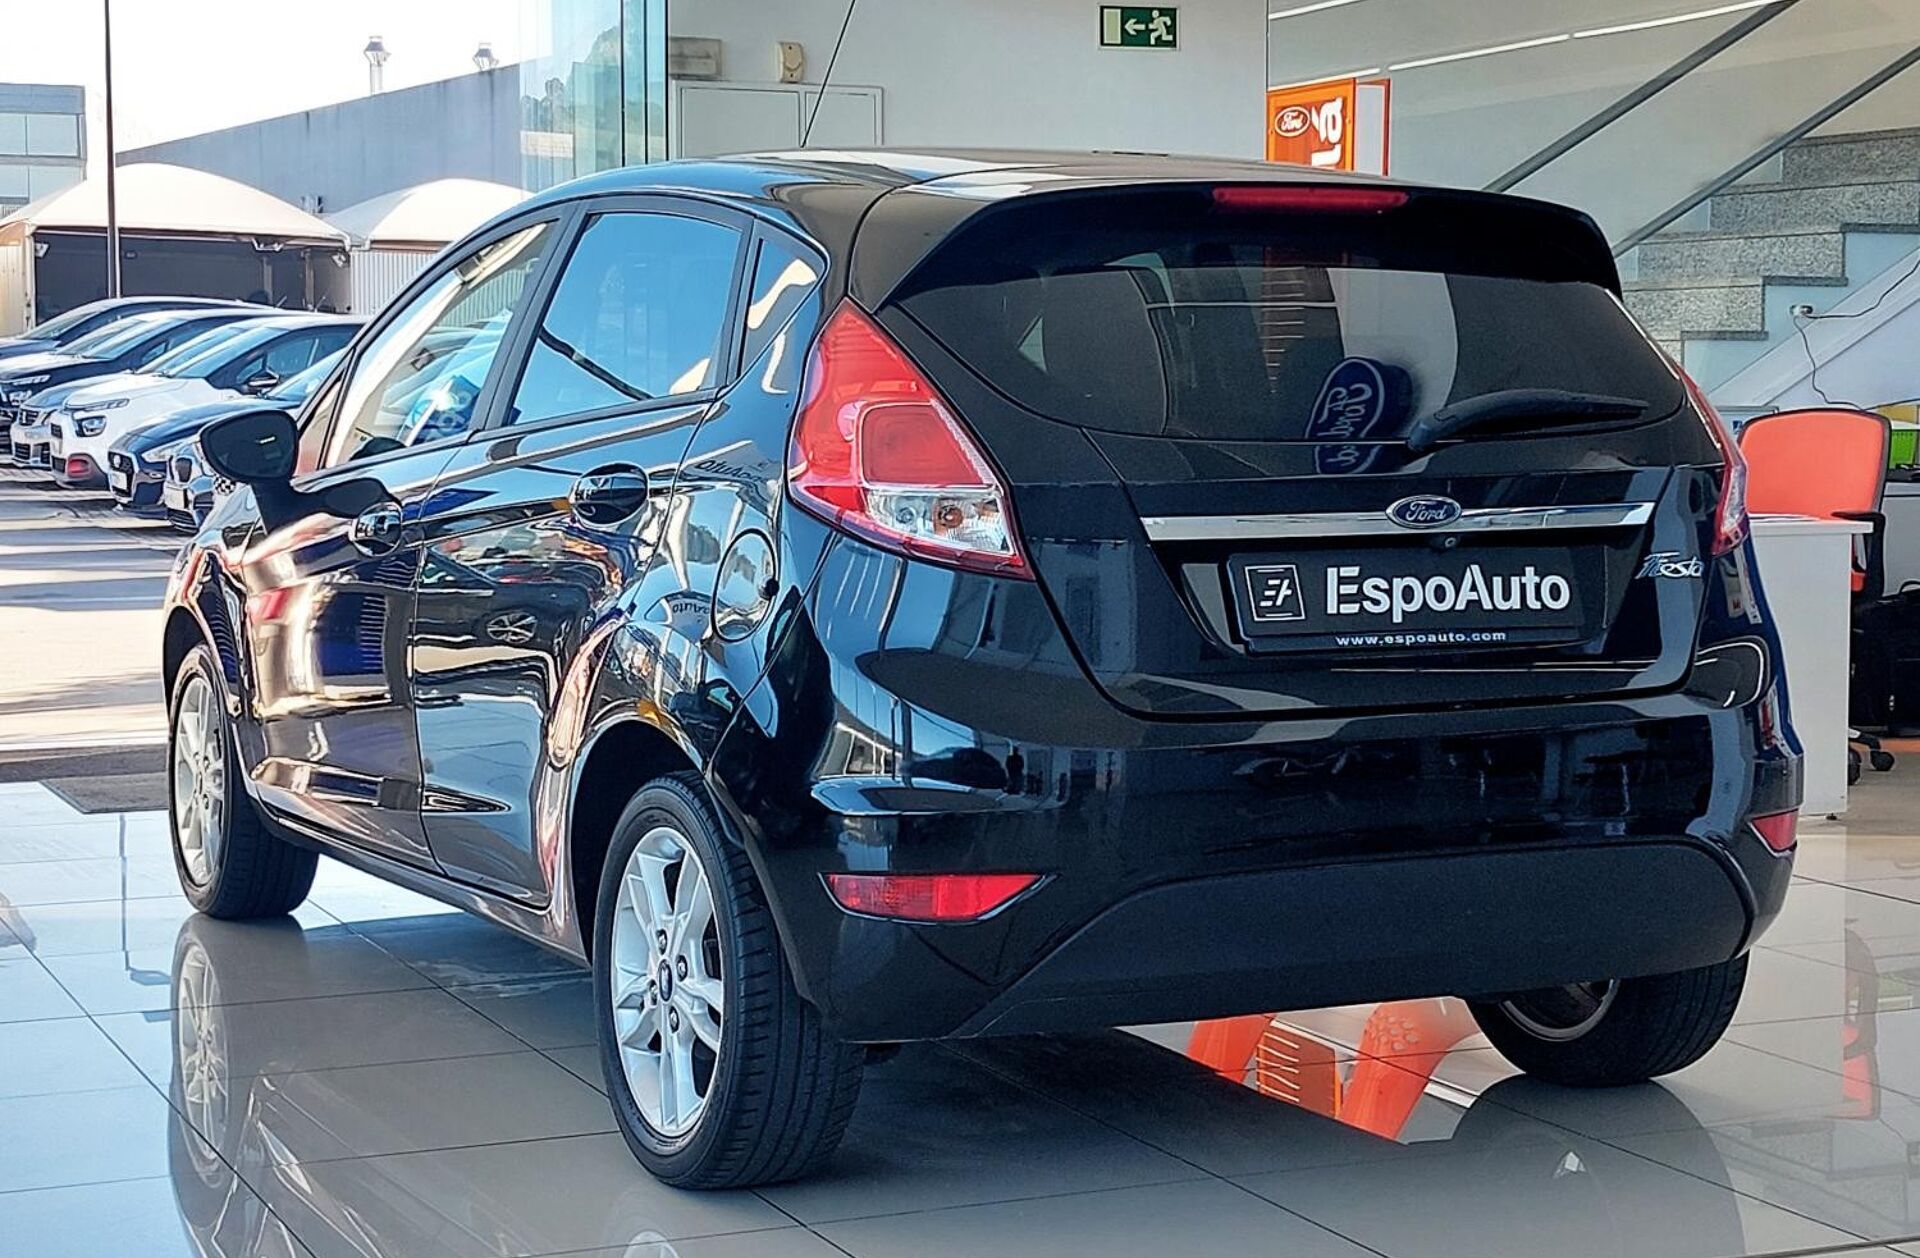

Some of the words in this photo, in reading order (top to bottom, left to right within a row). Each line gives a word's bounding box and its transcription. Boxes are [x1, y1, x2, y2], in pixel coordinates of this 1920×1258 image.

[1311, 97, 1343, 169] lá
[1405, 500, 1448, 521] Ford
[1326, 564, 1571, 623] EspoAuto
[1335, 630, 1506, 646] www.espoauto.com
